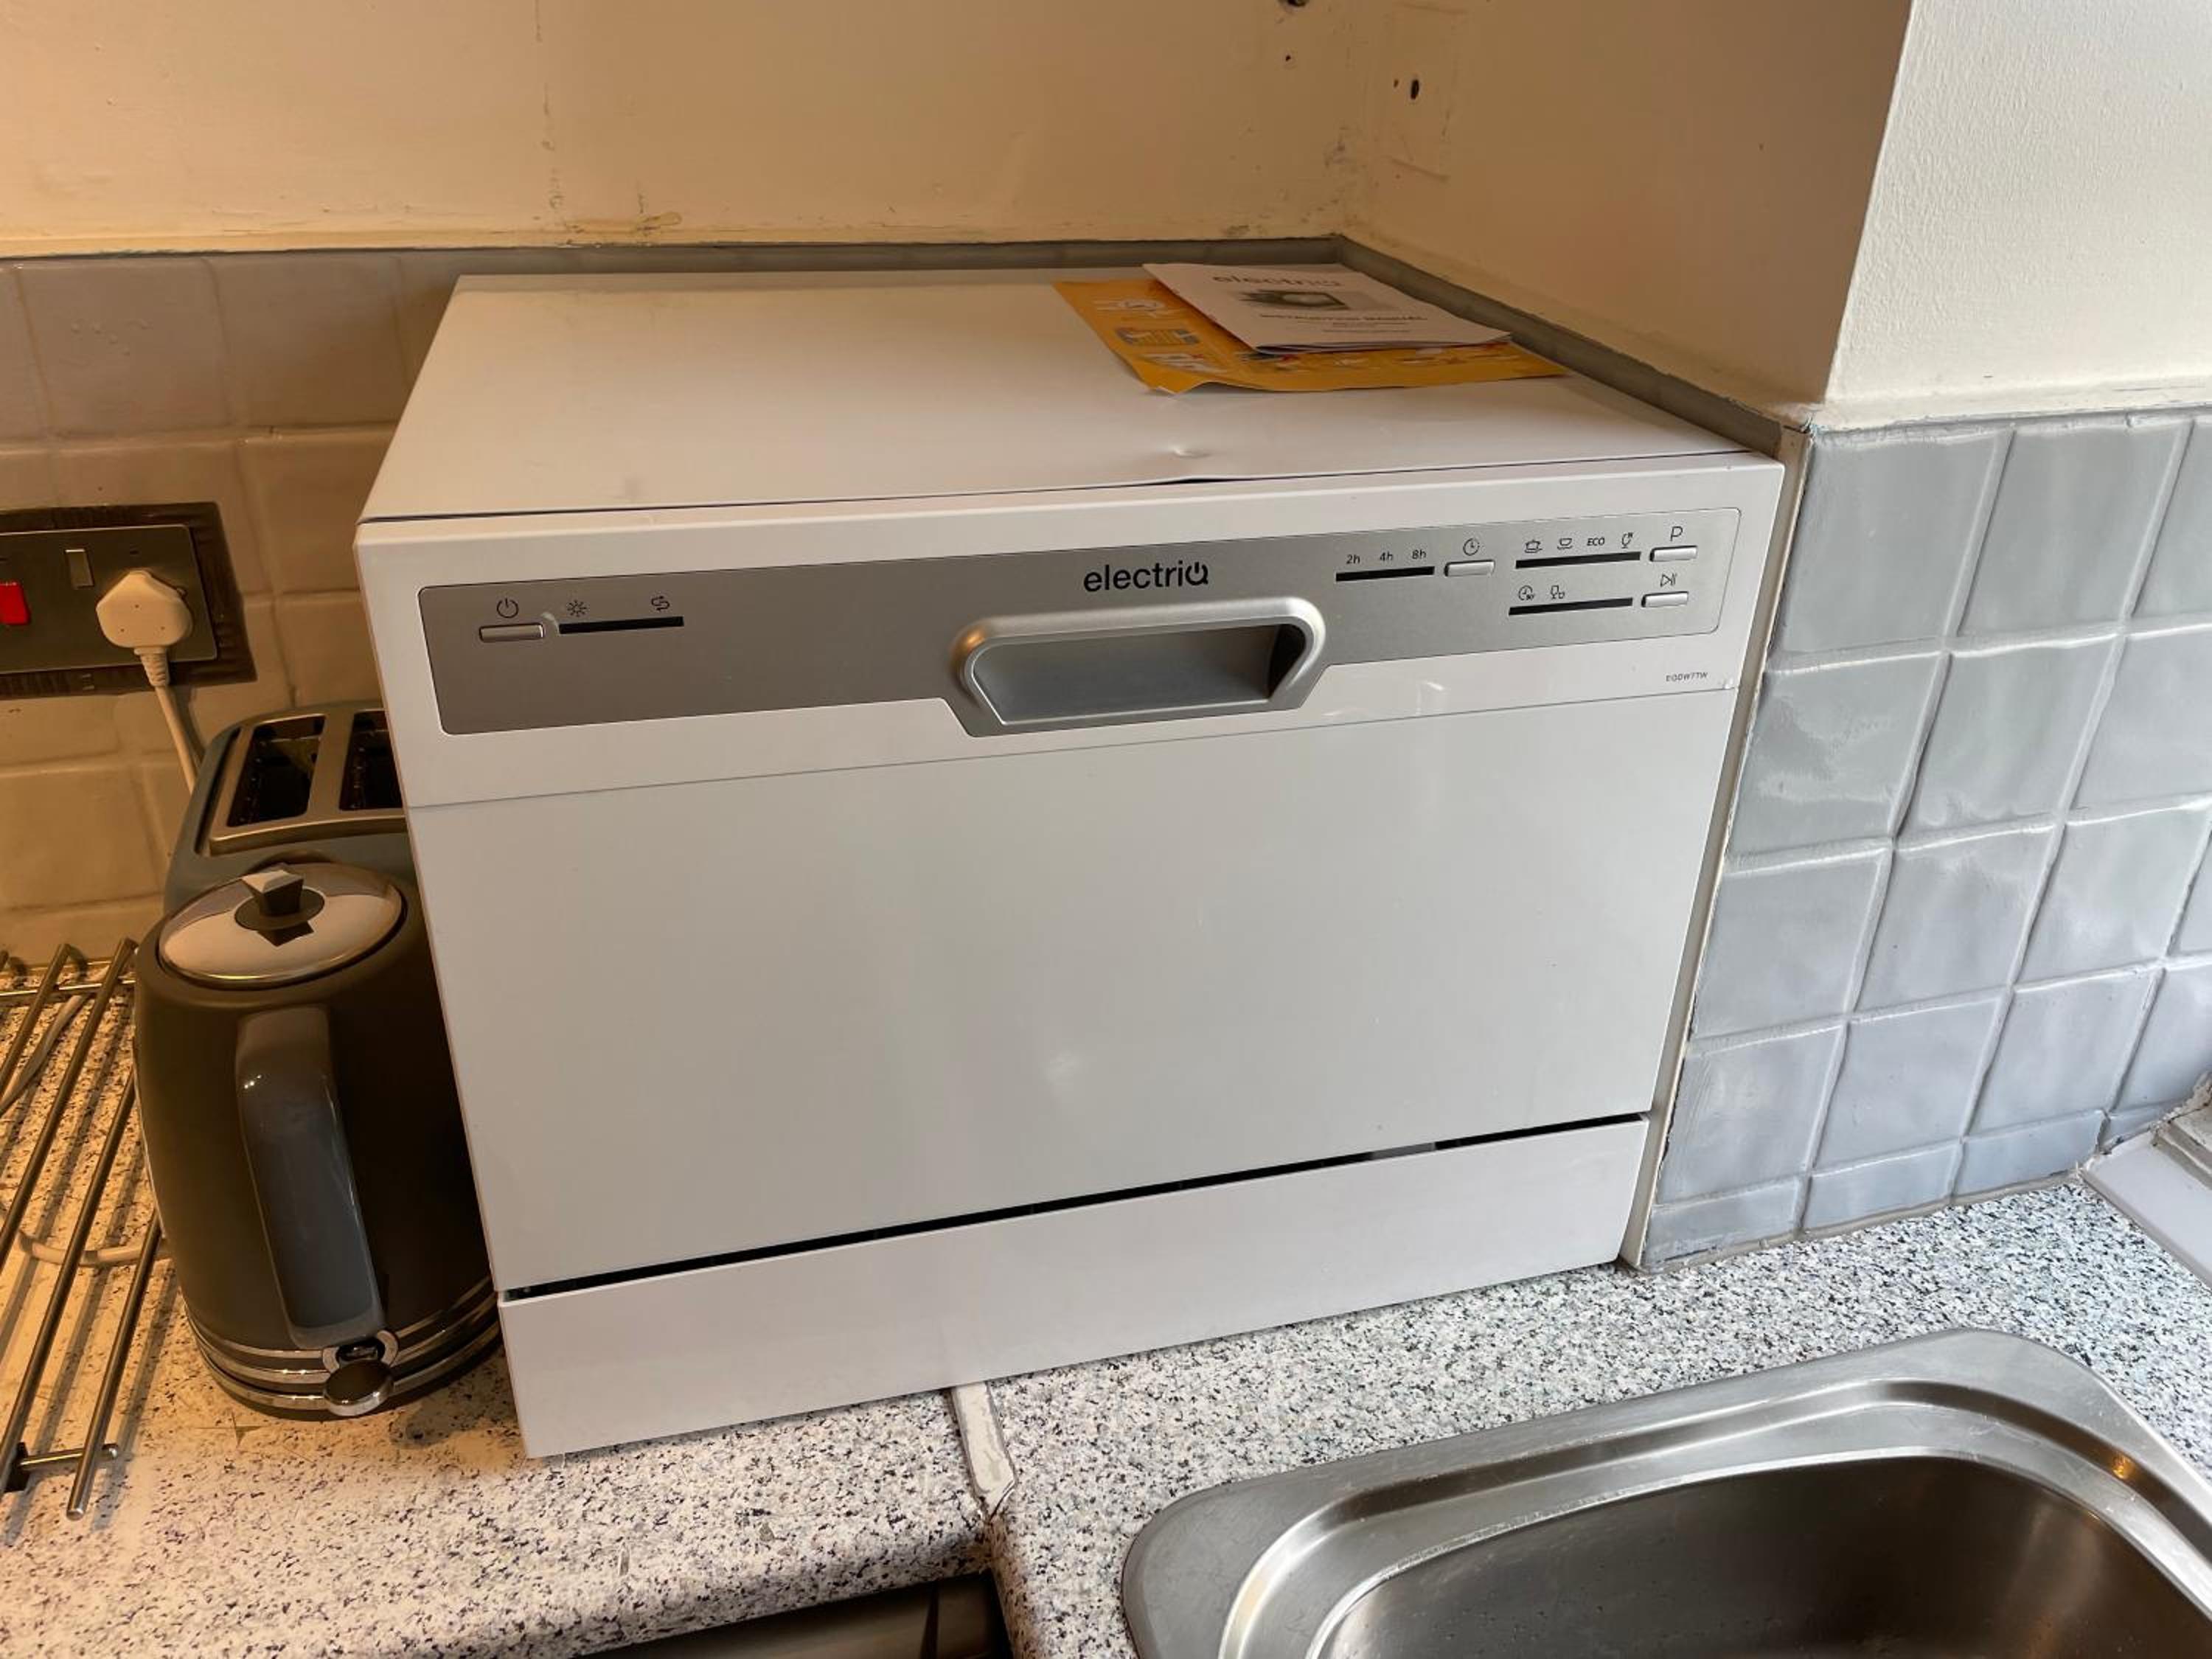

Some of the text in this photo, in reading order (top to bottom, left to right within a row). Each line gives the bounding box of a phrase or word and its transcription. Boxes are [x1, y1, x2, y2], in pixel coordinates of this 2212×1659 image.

[1670, 526, 1683, 541] P
[1587, 537, 1605, 546] ECO
[1346, 549, 1427, 564] 2h 4h 8h
